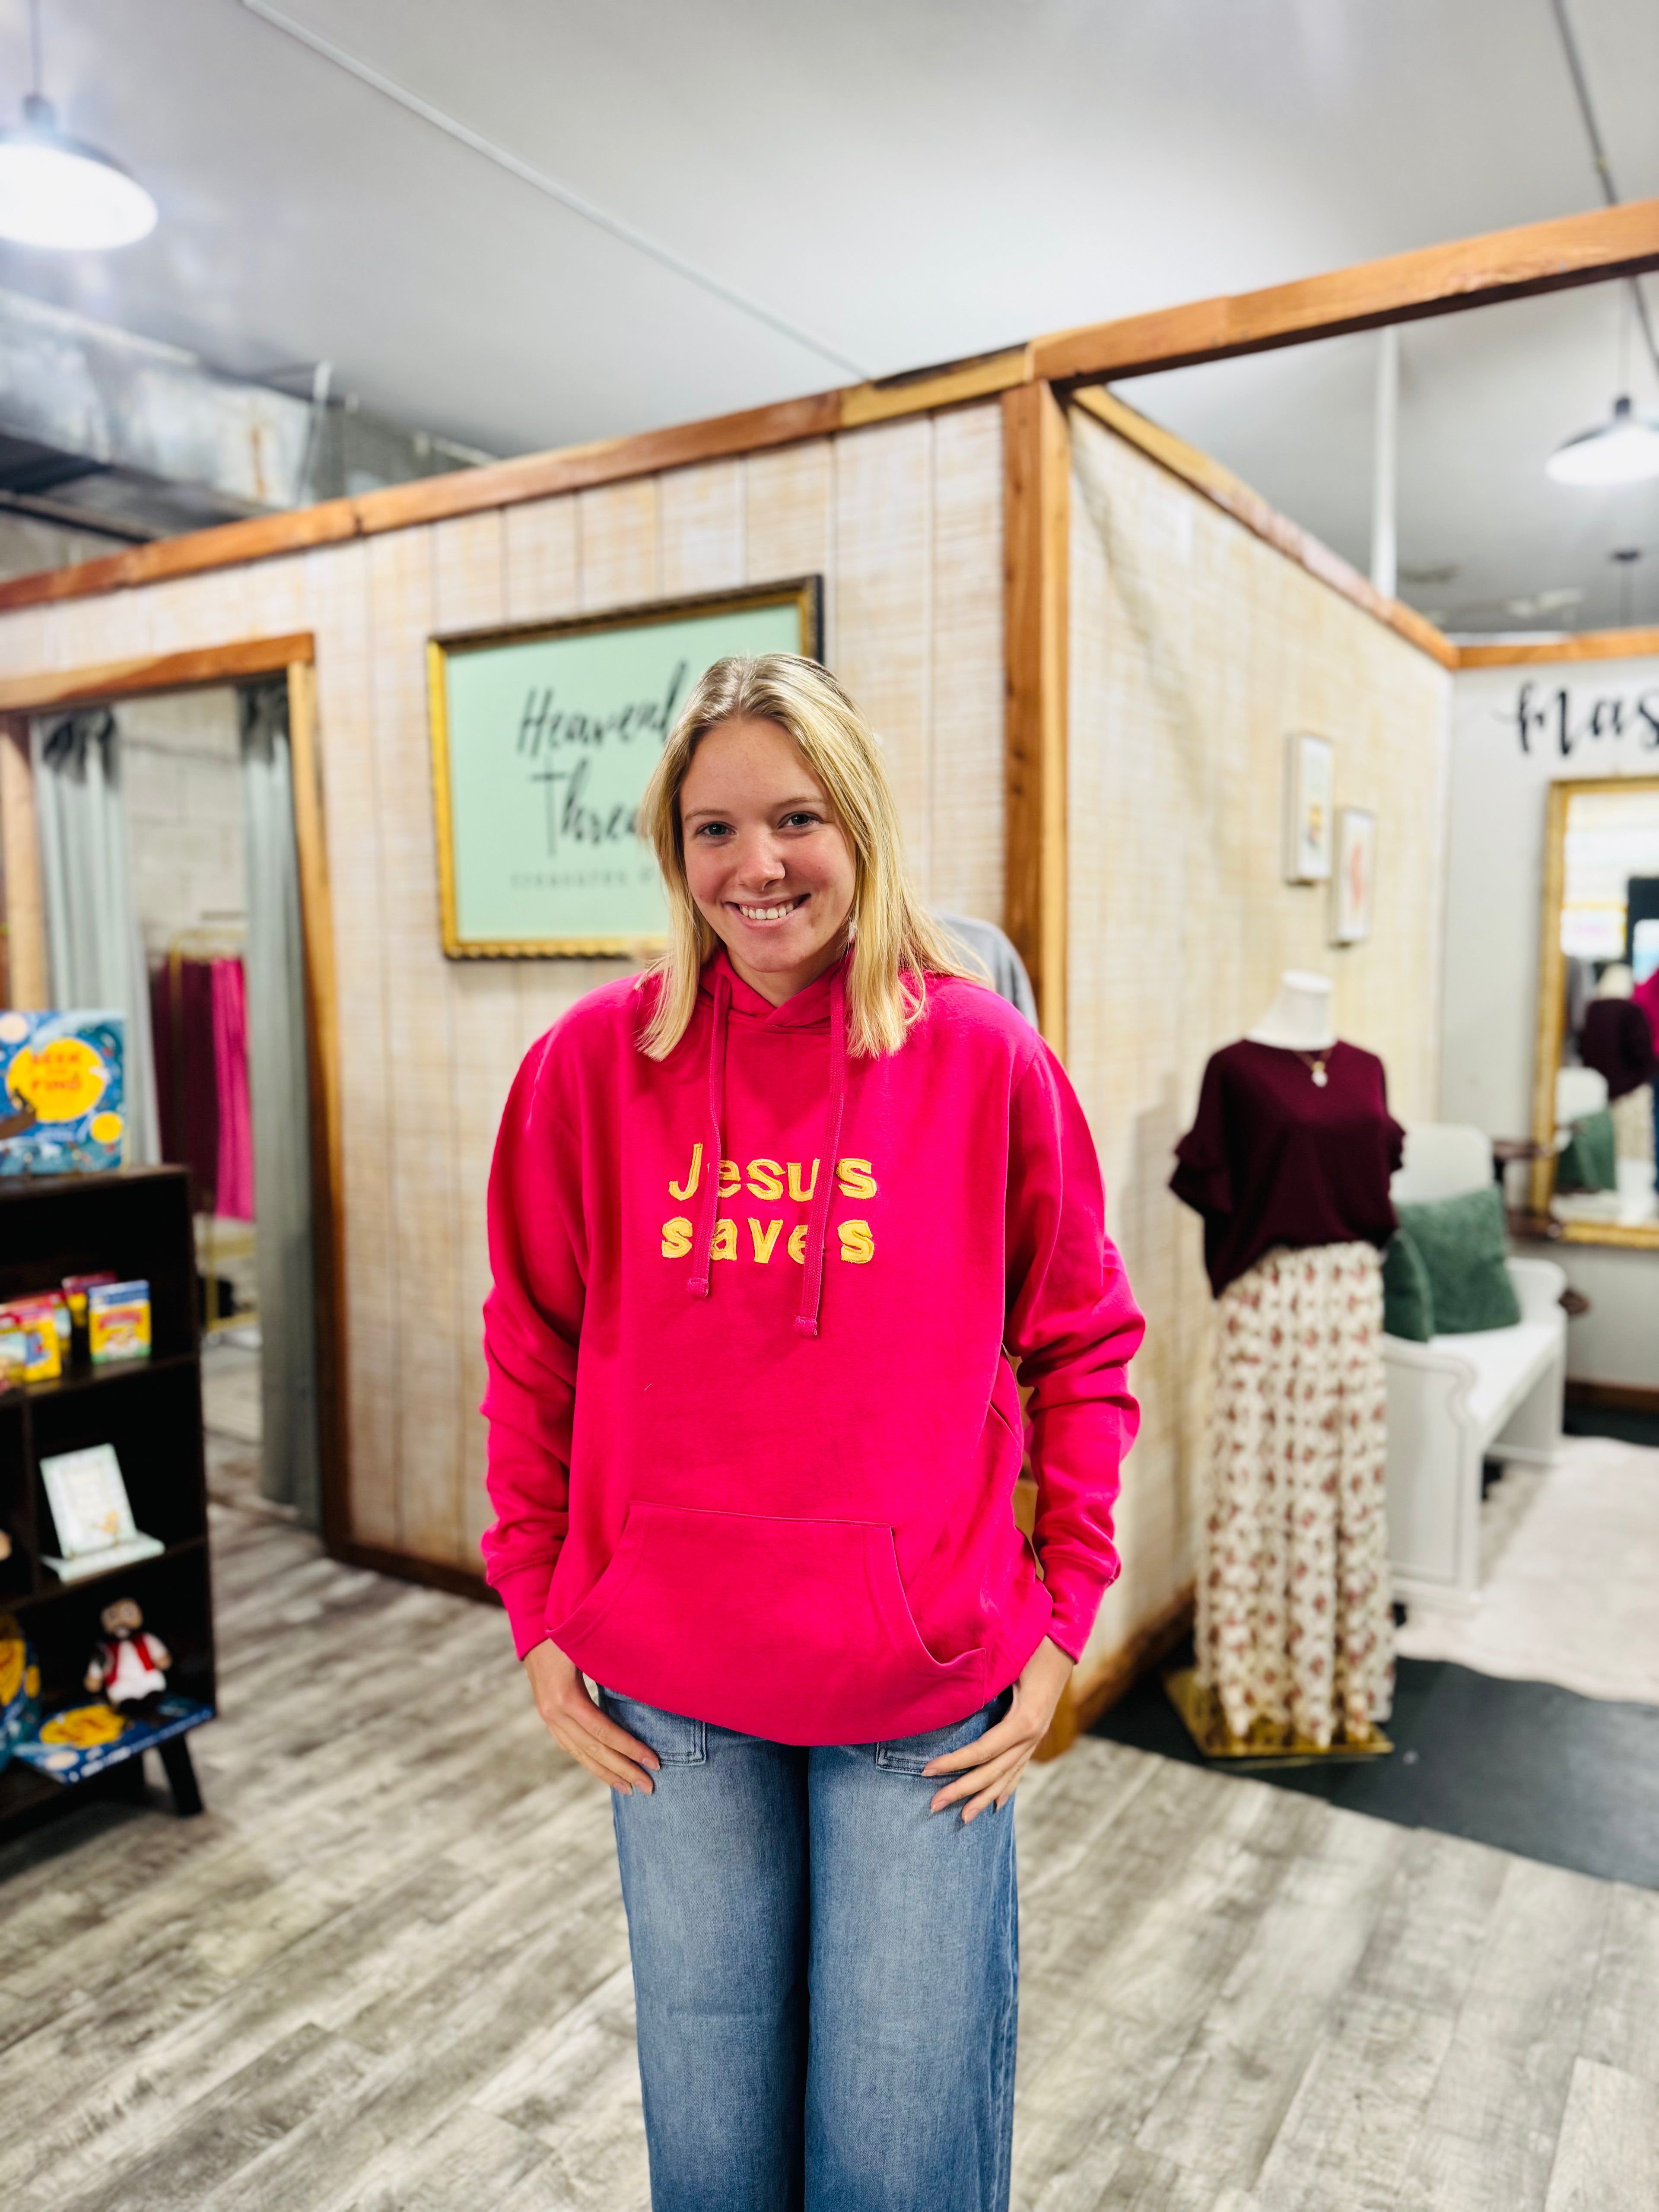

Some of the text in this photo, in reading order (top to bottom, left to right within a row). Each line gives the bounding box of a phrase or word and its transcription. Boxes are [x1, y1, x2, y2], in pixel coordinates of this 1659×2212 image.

[517, 658, 688, 759] Heavenl
[668, 1142, 877, 1202] Jesus
[661, 1216, 875, 1264] saves
